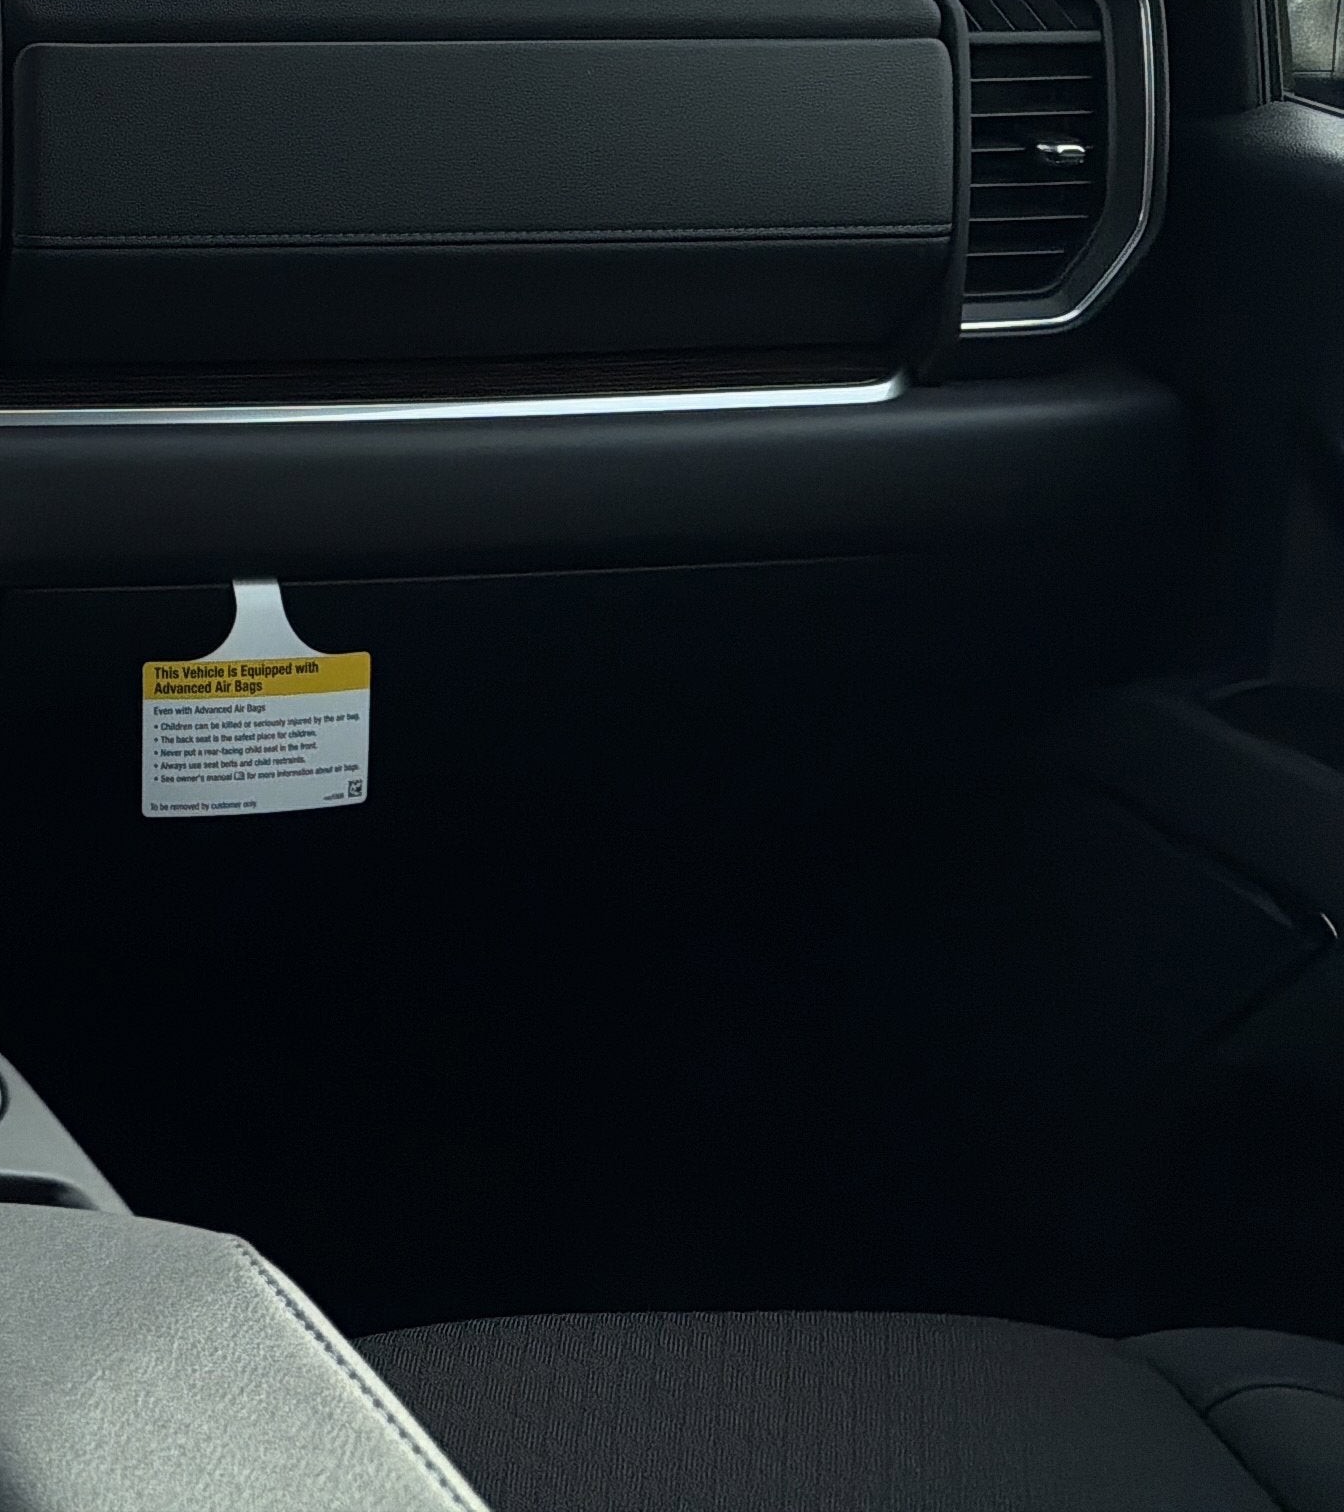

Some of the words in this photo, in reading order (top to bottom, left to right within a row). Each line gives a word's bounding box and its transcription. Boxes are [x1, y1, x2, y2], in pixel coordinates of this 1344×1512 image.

[154, 666, 179, 680] This
[183, 665, 224, 679] Vehicle
[240, 663, 292, 679] Equipped
[295, 661, 319, 674] with
[154, 681, 212, 694] Advanced
[215, 680, 231, 693] Air
[234, 679, 263, 694] Bags
[154, 706, 173, 715] Even
[175, 706, 192, 715] with
[194, 705, 232, 714] Advanced
[234, 704, 245, 713] Air
[247, 703, 266, 713] Bags
[161, 722, 192, 731] Children
[210, 721, 220, 730] be
[222, 720, 242, 729] killed
[244, 721, 251, 729] or
[254, 718, 285, 728] seriously
[287, 717, 312, 727] injured
[314, 716, 322, 726] by
[324, 715, 334, 723] the
[336, 714, 346, 722] air
[161, 735, 174, 744] The
[176, 735, 194, 744] back
[196, 734, 211, 743] seat
[213, 734, 219, 742] is
[221, 734, 232, 742] the
[234, 733, 255, 741] safest
[257, 732, 276, 742] place
[277, 731, 287, 739] for
[161, 761, 186, 771] Always
[203, 760, 219, 769] seat
[220, 759, 238, 768] belts
[240, 759, 252, 767] and
[254, 758, 271, 766] child
[151, 803, 158, 811] To
[160, 802, 169, 811] be
[170, 802, 200, 811] removed
[201, 802, 209, 811] by
[211, 800, 241, 809] customer
